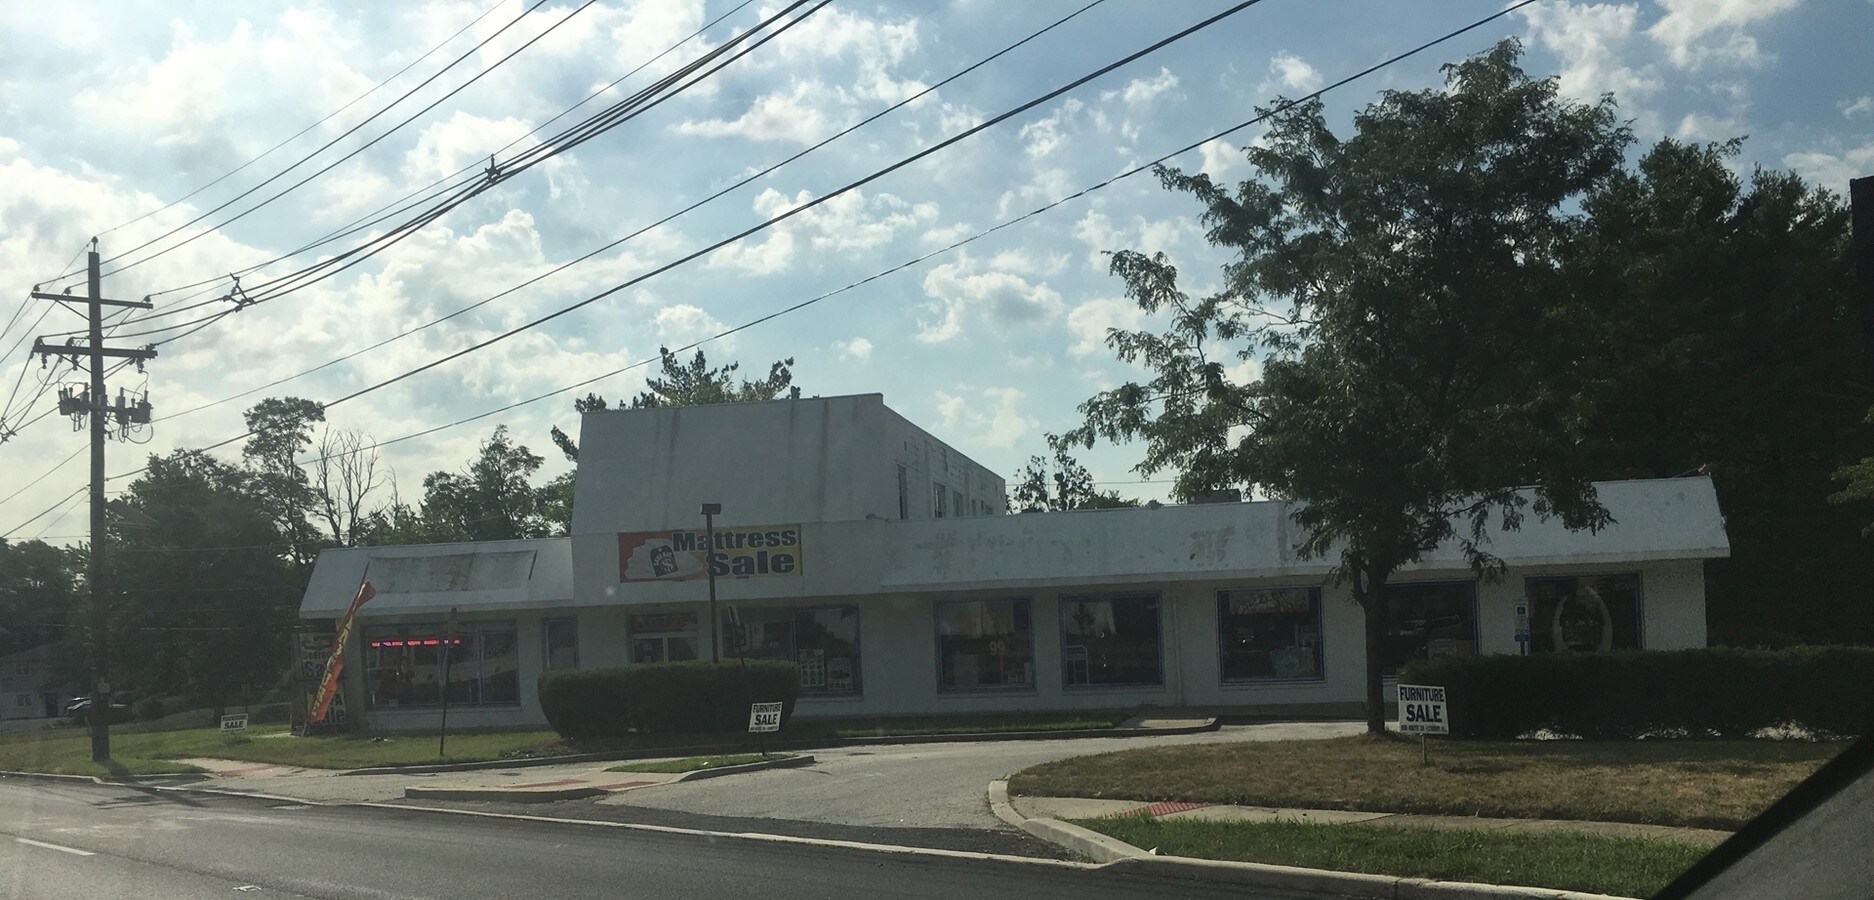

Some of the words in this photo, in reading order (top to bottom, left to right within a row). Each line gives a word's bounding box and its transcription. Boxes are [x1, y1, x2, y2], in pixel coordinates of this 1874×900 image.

[673, 529, 796, 551] Mattress
[707, 550, 795, 577] Sale
[1400, 687, 1444, 702] FURNITURE
[753, 703, 781, 713] FURNITURE
[1406, 704, 1442, 723] SALE
[224, 720, 244, 729] SALE
[754, 713, 778, 726] SALE
